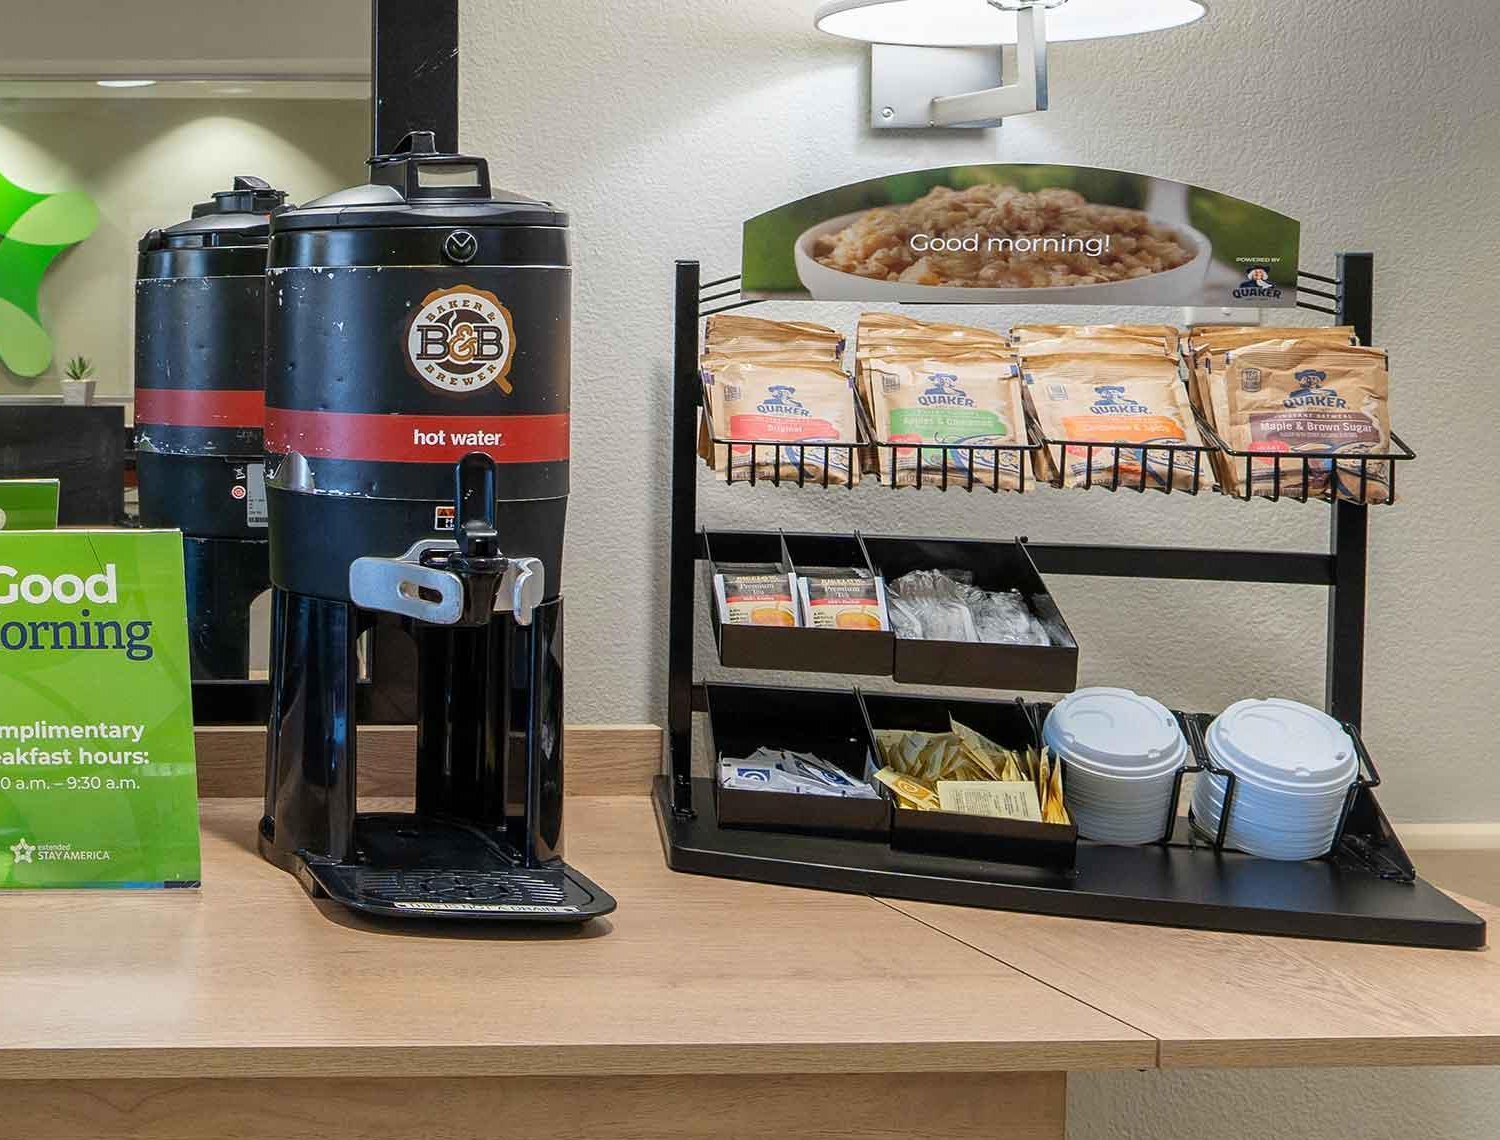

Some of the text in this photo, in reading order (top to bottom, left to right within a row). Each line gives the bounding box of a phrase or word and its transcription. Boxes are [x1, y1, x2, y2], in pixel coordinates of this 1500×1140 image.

[910, 233, 1110, 256] Good morning!
[1232, 288, 1281, 298] QUAKER
[426, 300, 482, 322] BAKER
[416, 324, 504, 361] B&B
[424, 364, 497, 386] BREWER
[918, 396, 974, 407] QUAKER
[1284, 397, 1346, 408] QUAKER
[756, 404, 810, 417] QUAKER
[1090, 406, 1148, 414] QUAKER
[1260, 422, 1372, 433] Maple & Brown Sugar
[414, 429, 502, 446] hot water
[79, 748, 150, 766] hours:
[16, 778, 50, 790] a.m.
[67, 776, 101, 790] 9:30
[106, 777, 140, 790] a.m.
